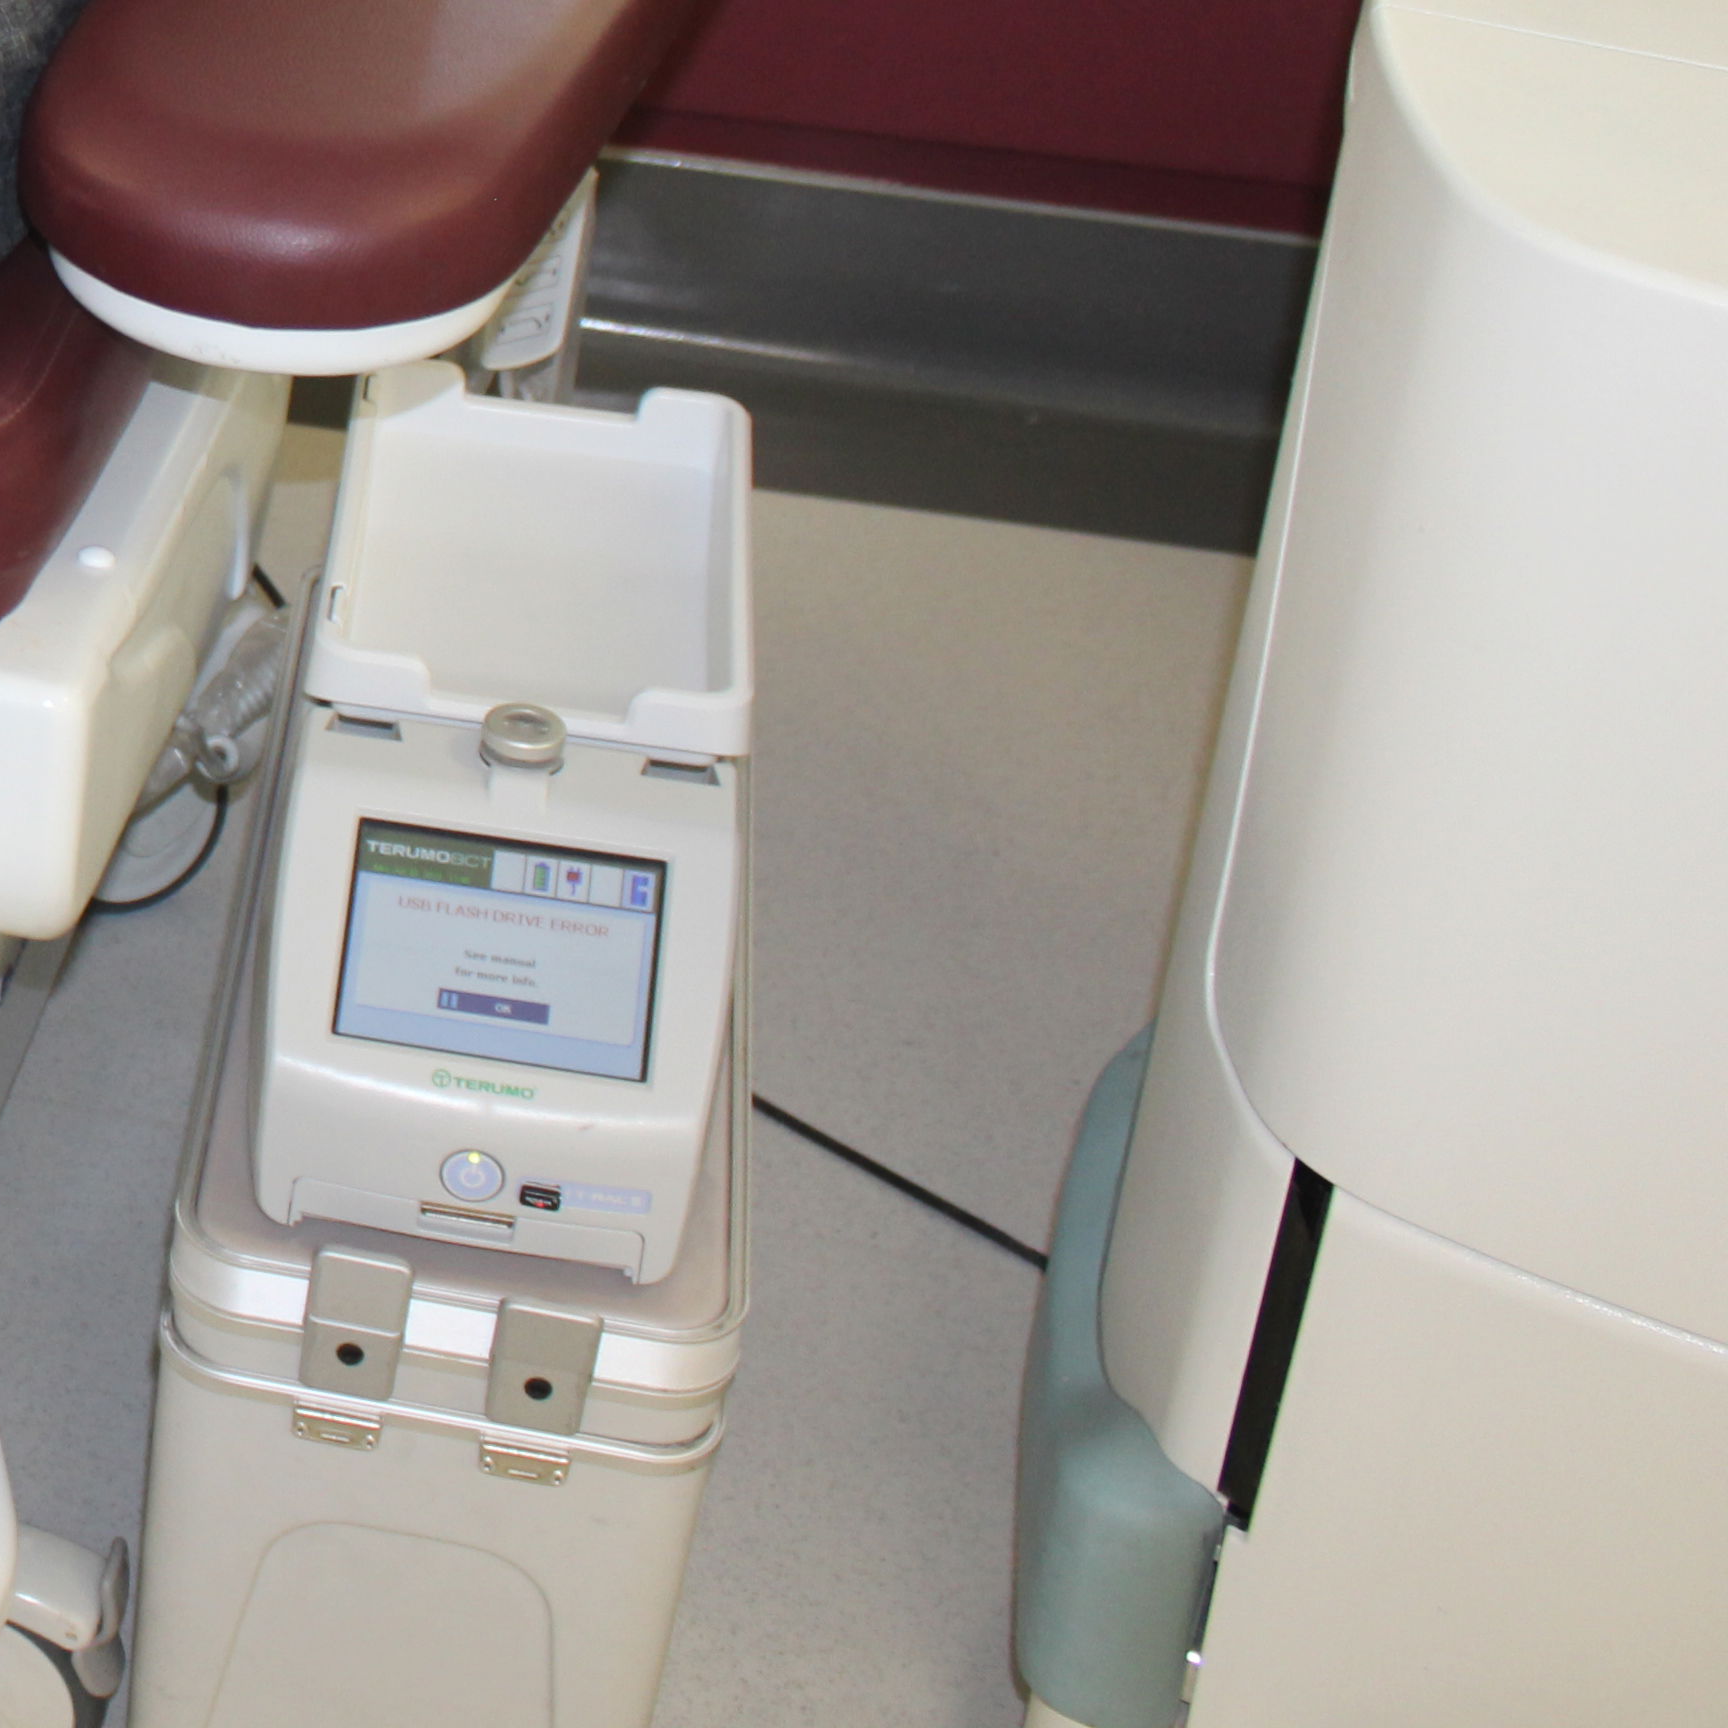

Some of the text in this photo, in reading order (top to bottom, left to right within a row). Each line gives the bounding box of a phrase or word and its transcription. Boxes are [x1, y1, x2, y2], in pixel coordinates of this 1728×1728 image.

[397, 895, 610, 938] USB FLASH DRIVE ERROR
[463, 948, 537, 969] See manual
[477, 970, 509, 983] more
[495, 1002, 512, 1015] OK
[453, 1077, 535, 1100] TERUMO
